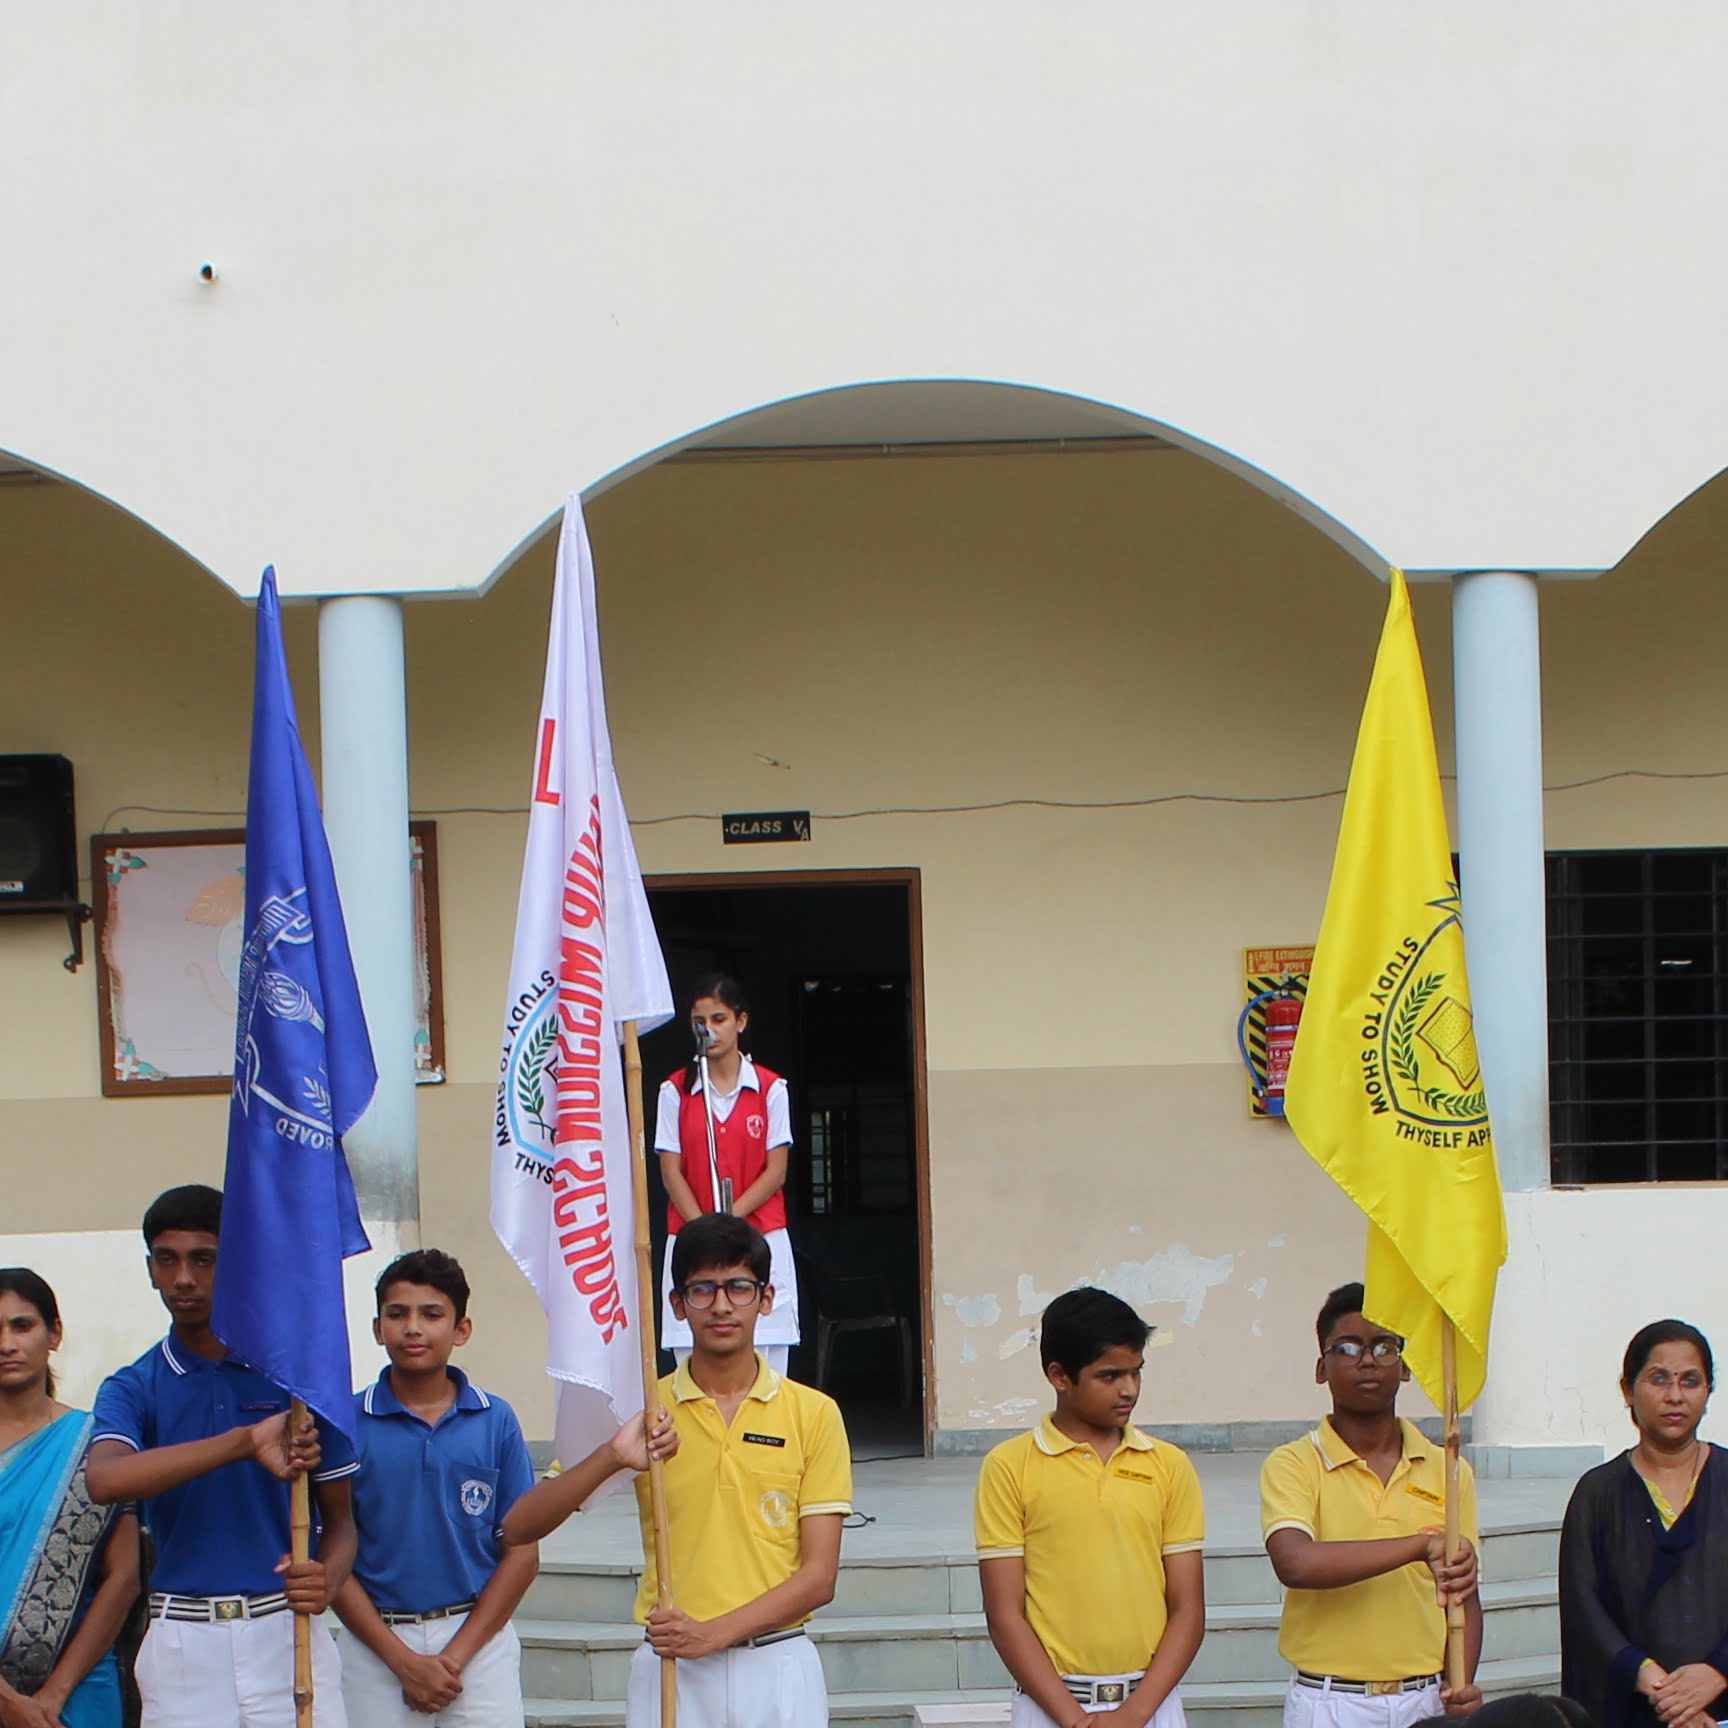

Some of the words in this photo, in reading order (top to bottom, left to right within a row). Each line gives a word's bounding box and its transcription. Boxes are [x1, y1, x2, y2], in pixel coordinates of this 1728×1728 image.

[729, 821, 782, 834] CLASS
[1369, 936, 1419, 1006] STUDY
[506, 969, 556, 1037] STUDY
[1362, 1012, 1382, 1040] TO
[499, 1043, 512, 1073] TO
[1361, 1049, 1390, 1116] SHOW
[496, 1081, 512, 1147] SHOW
[1394, 1120, 1463, 1149] THYSELF
